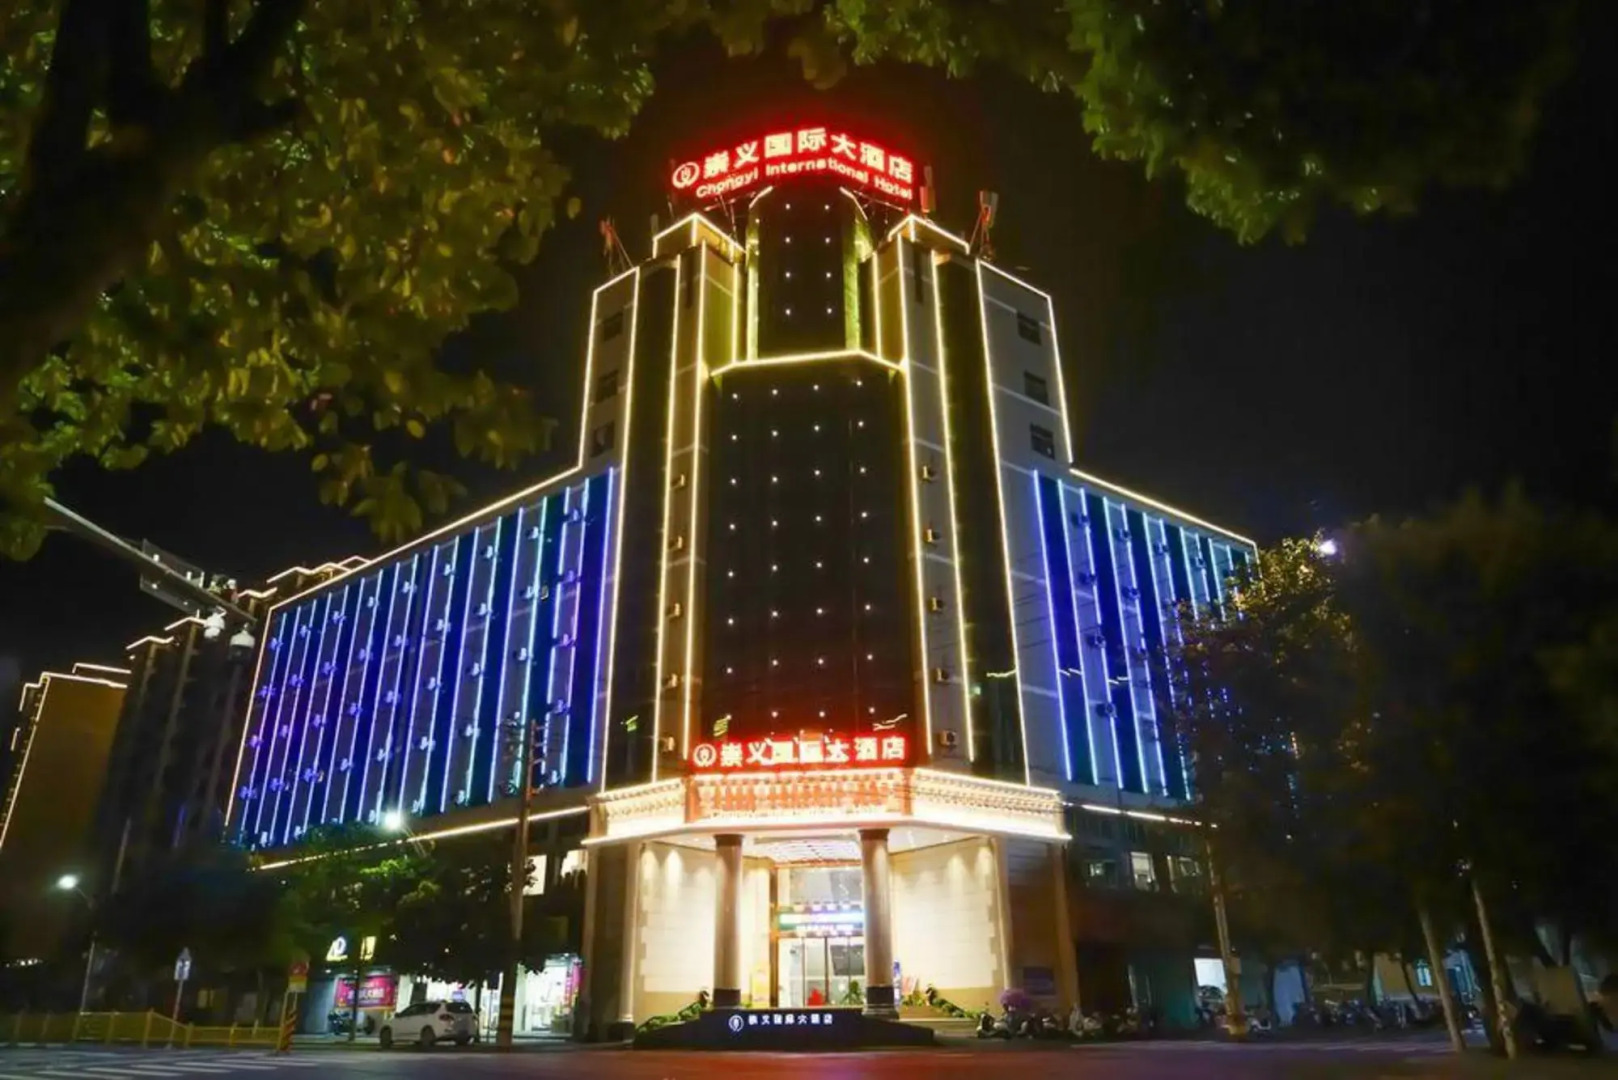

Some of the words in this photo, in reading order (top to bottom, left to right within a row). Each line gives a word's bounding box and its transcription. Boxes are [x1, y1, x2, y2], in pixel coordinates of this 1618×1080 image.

[696, 166, 759, 198] Chongyi
[766, 157, 869, 184] International
[874, 174, 913, 200] Hotel
[703, 127, 912, 184] 崇义国际大酒店
